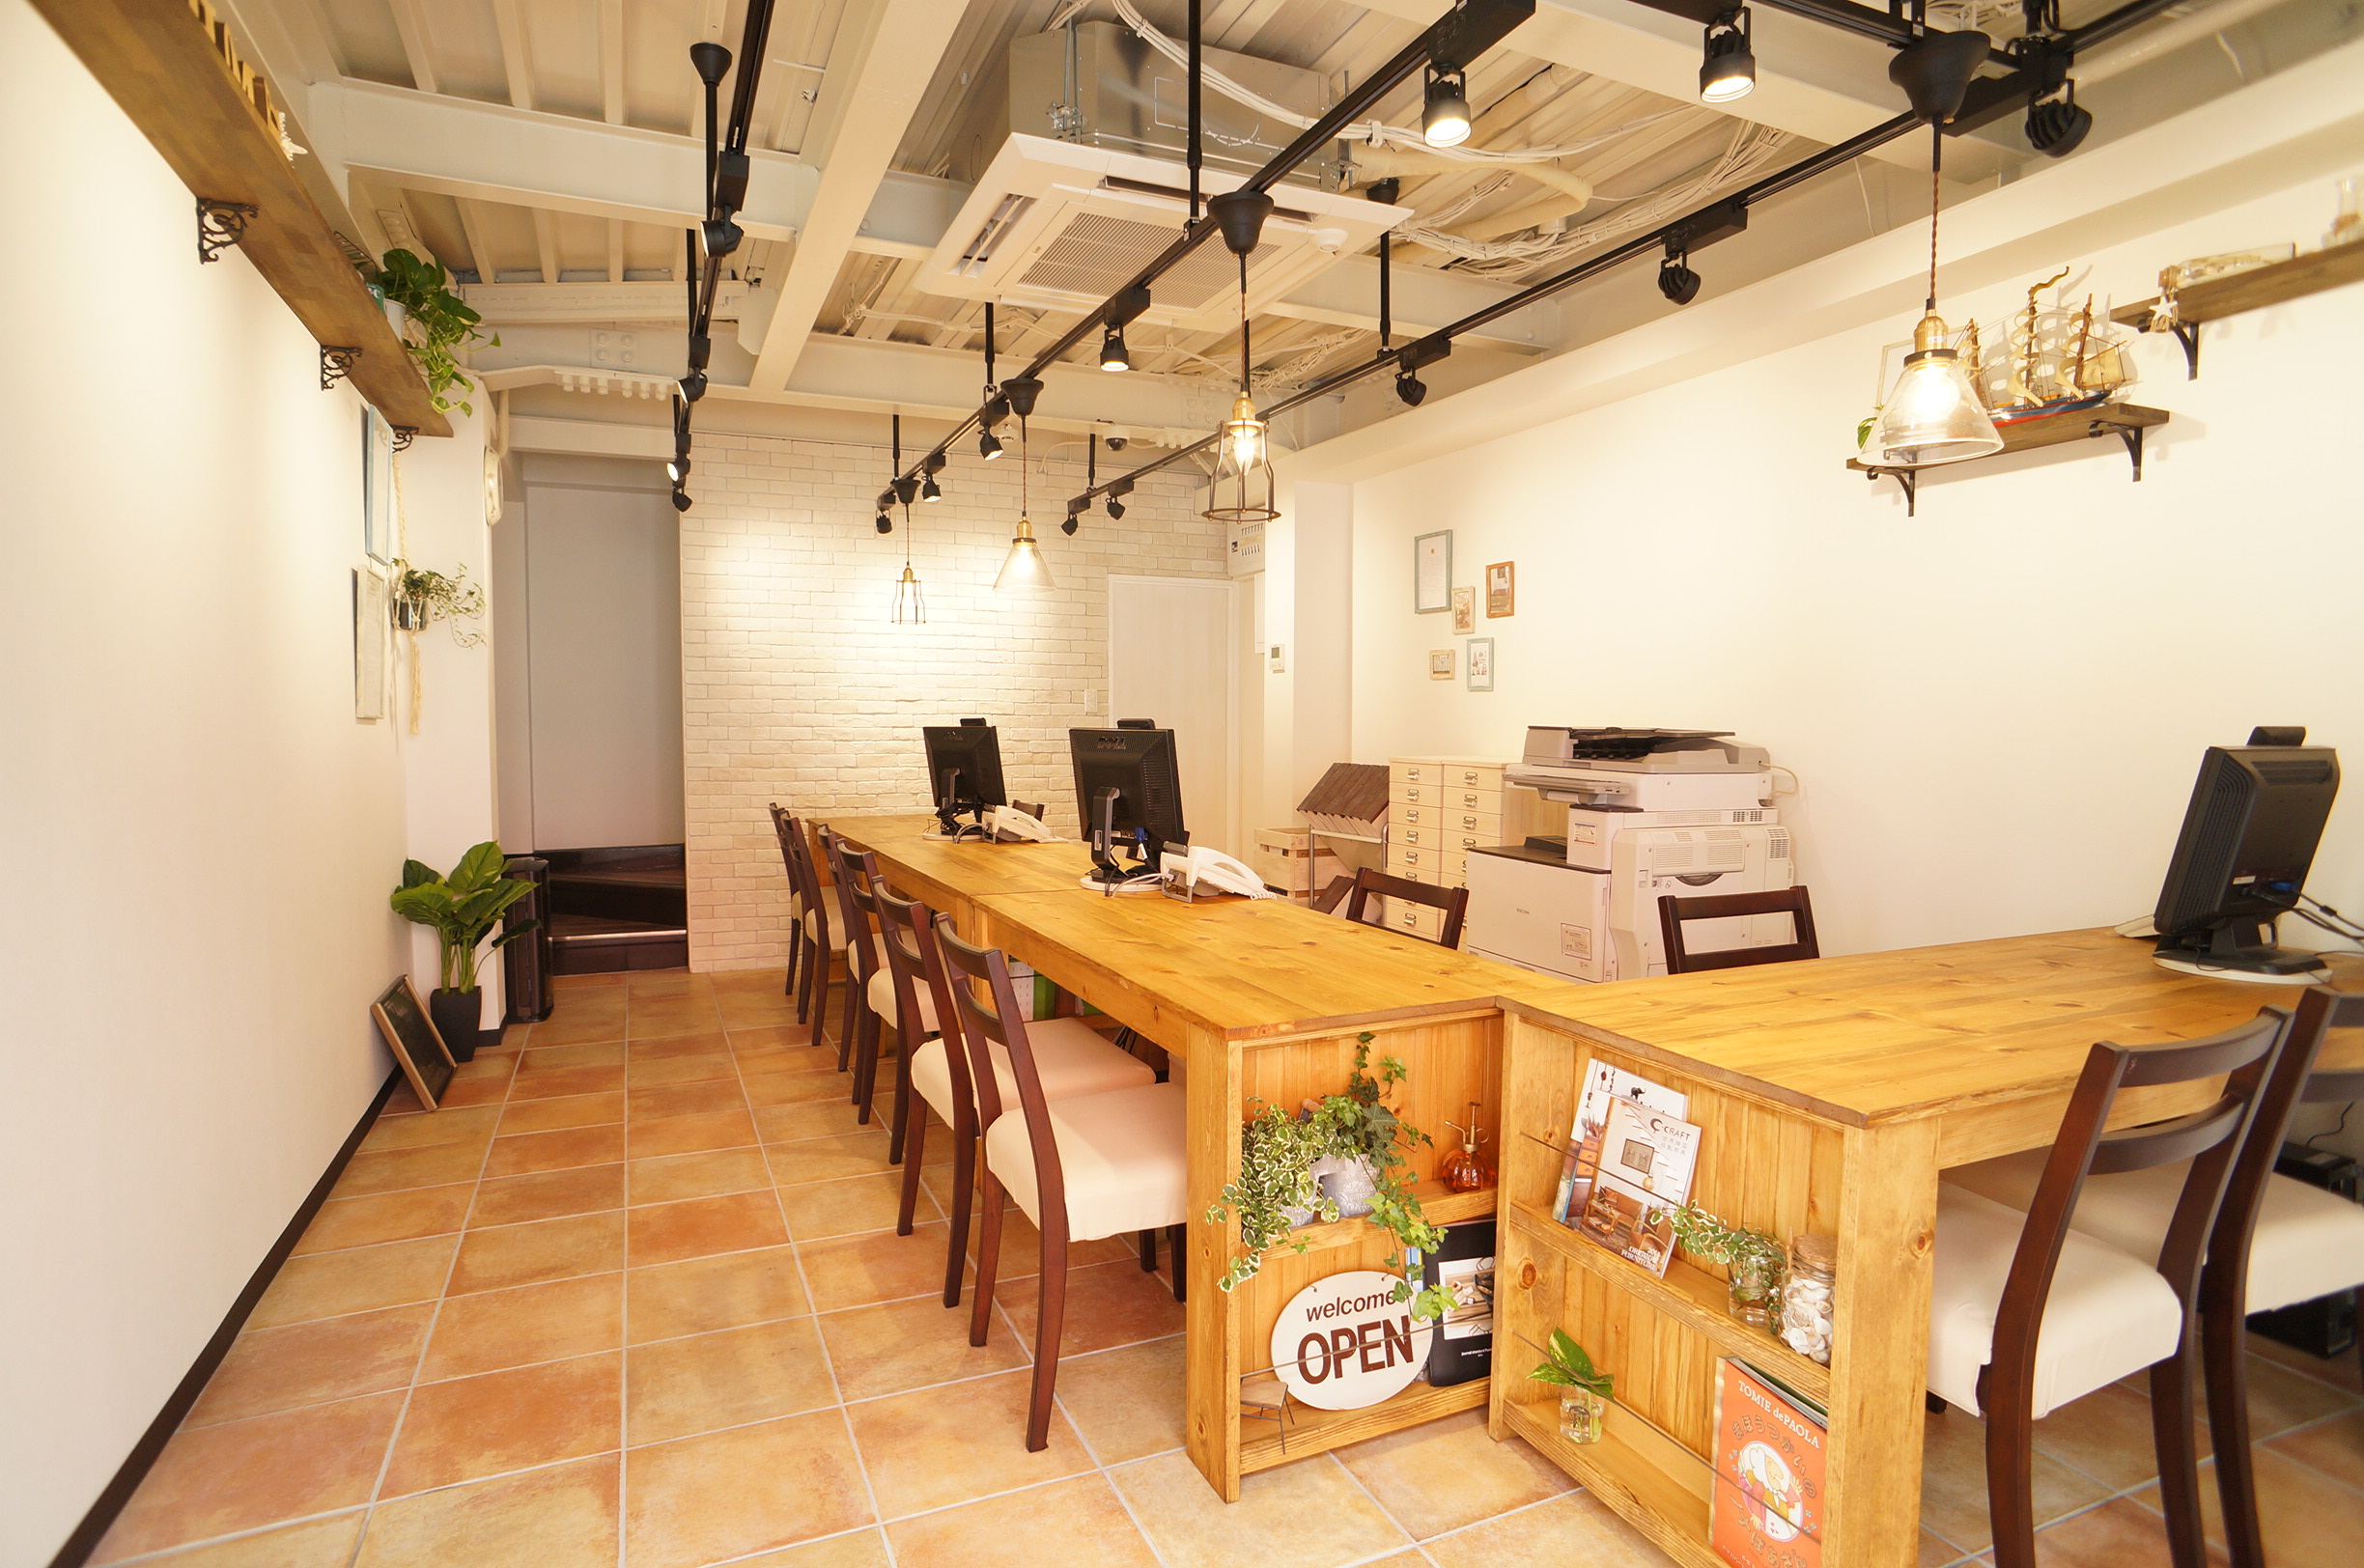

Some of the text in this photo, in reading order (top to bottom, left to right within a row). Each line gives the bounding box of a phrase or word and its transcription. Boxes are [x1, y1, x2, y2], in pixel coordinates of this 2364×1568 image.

[1306, 1290, 1397, 1323] welcome
[1297, 1314, 1415, 1386] OPEN
[1738, 1380, 1820, 1449] TOMIE dePAOLA
